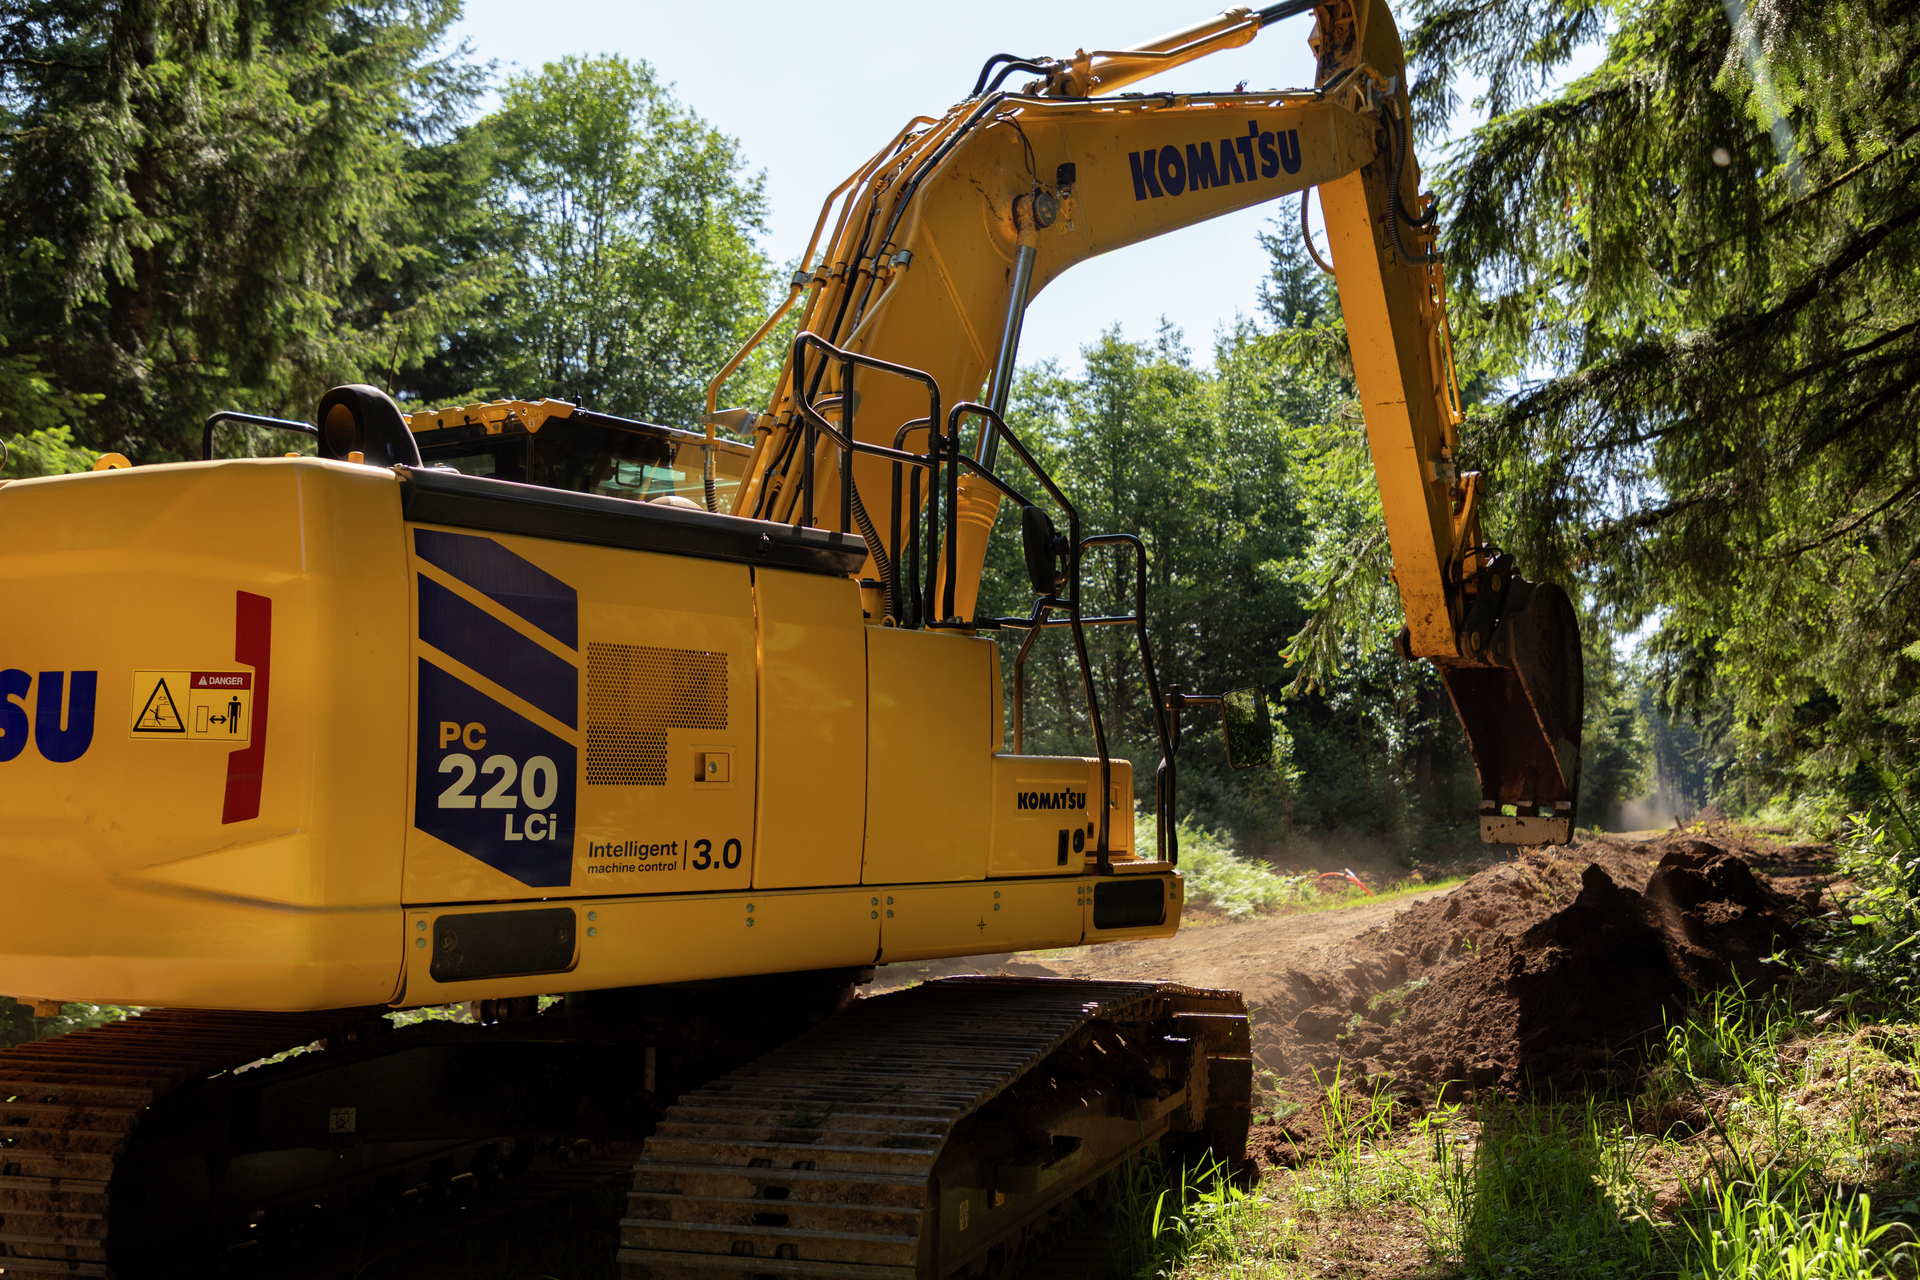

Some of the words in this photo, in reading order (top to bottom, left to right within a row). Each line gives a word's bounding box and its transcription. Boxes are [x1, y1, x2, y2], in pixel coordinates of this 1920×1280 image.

[1128, 120, 1302, 201] KOMATSU
[208, 676, 243, 686] DANGER
[439, 721, 487, 751] PC
[437, 753, 558, 810] 220
[1017, 787, 1086, 810] KOMATSU
[504, 812, 557, 841] LCi
[588, 840, 678, 861] Intelligent
[692, 838, 742, 871] 3.0
[587, 862, 636, 874] machine
[638, 860, 677, 873] control
